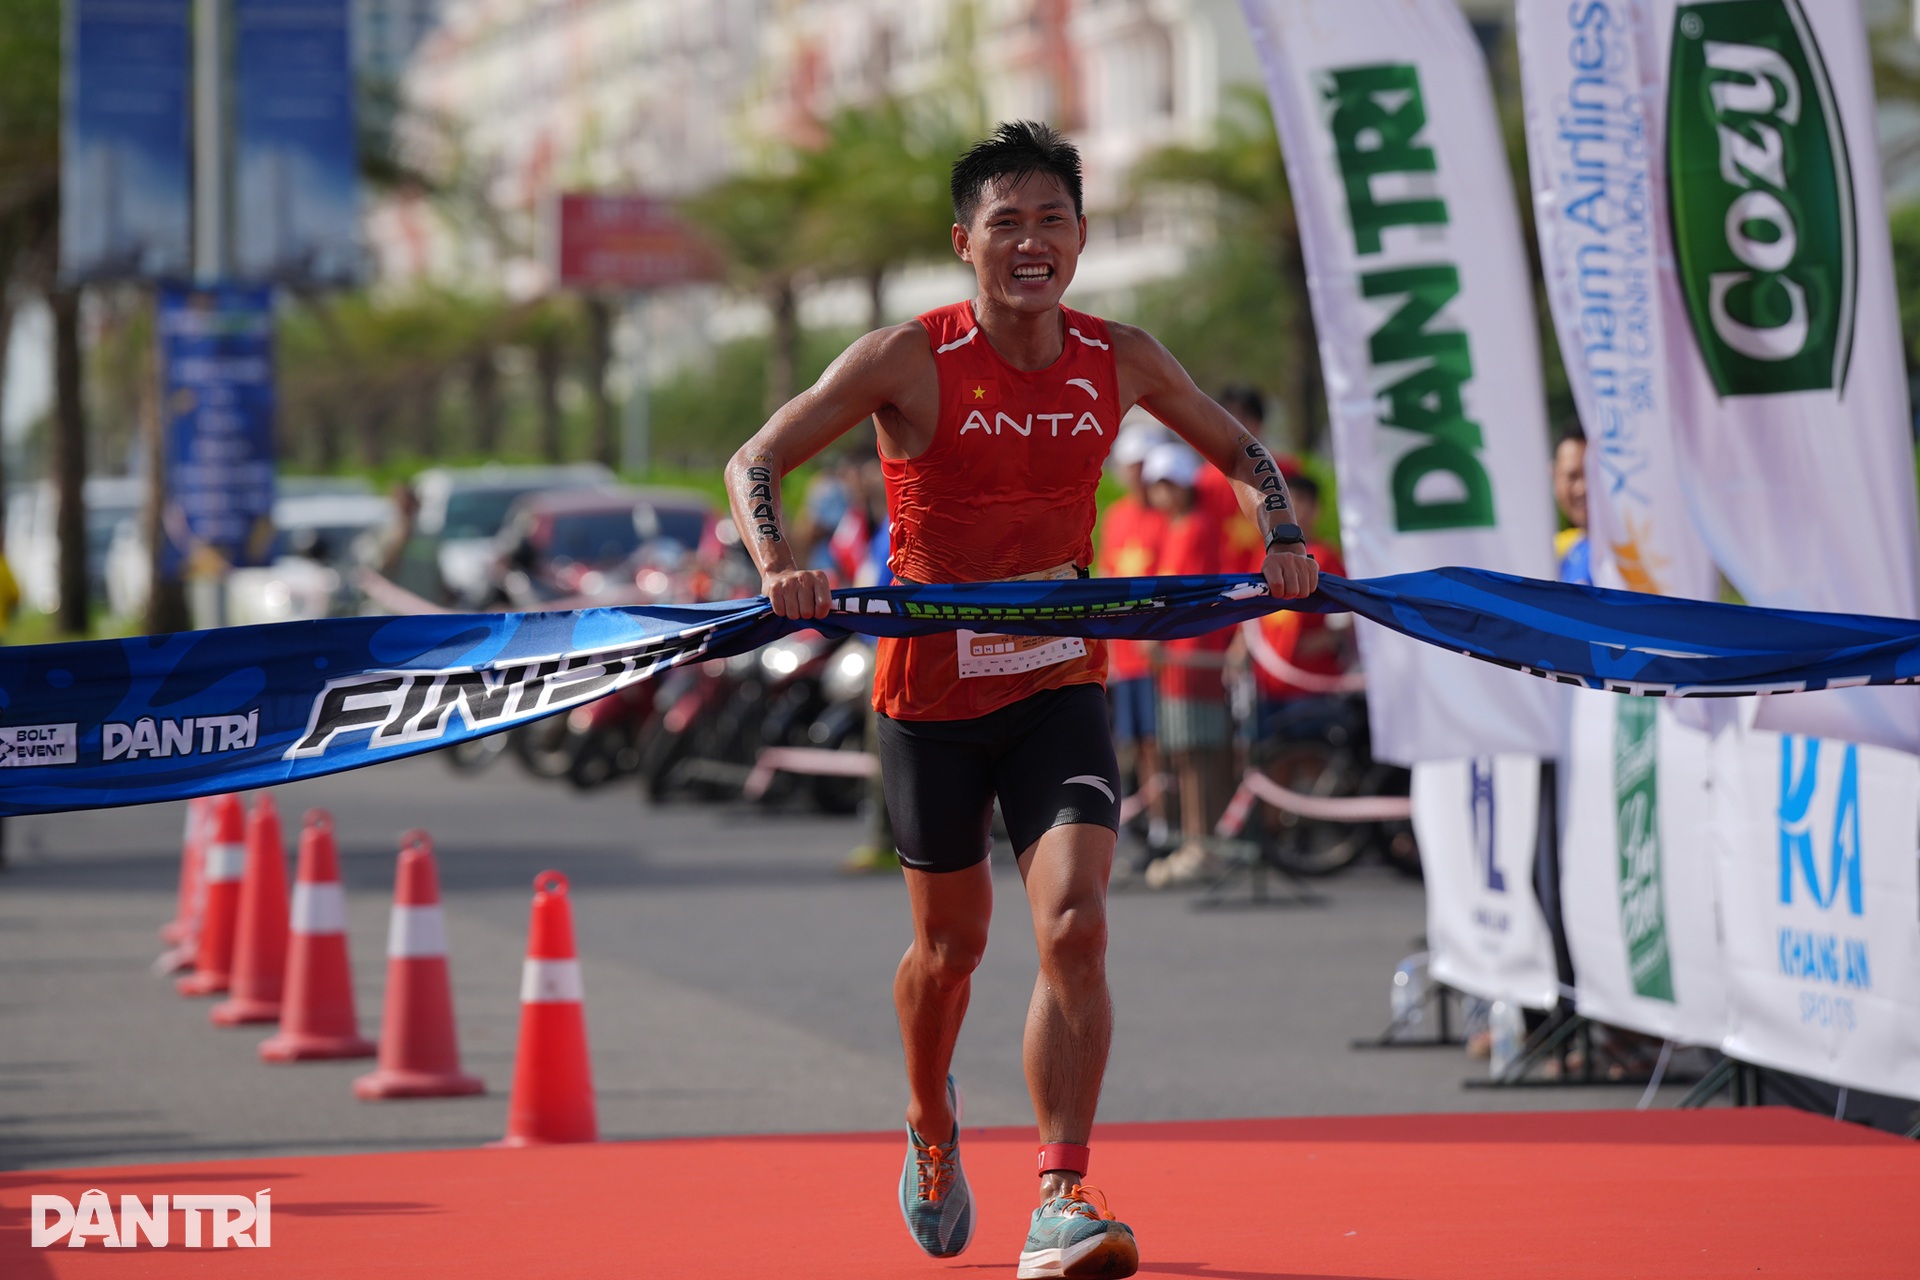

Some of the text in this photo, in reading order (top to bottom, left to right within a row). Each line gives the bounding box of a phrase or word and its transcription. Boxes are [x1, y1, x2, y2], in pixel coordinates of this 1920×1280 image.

[1702, 40, 1810, 362] Cozy
[959, 410, 1103, 437] ANTA
[1245, 443, 1288, 512] 6448
[747, 466, 781, 543] 6448
[16, 728, 57, 742] BOLT
[17, 744, 65, 758] EVENT
[1843, 938, 1873, 989] AN
